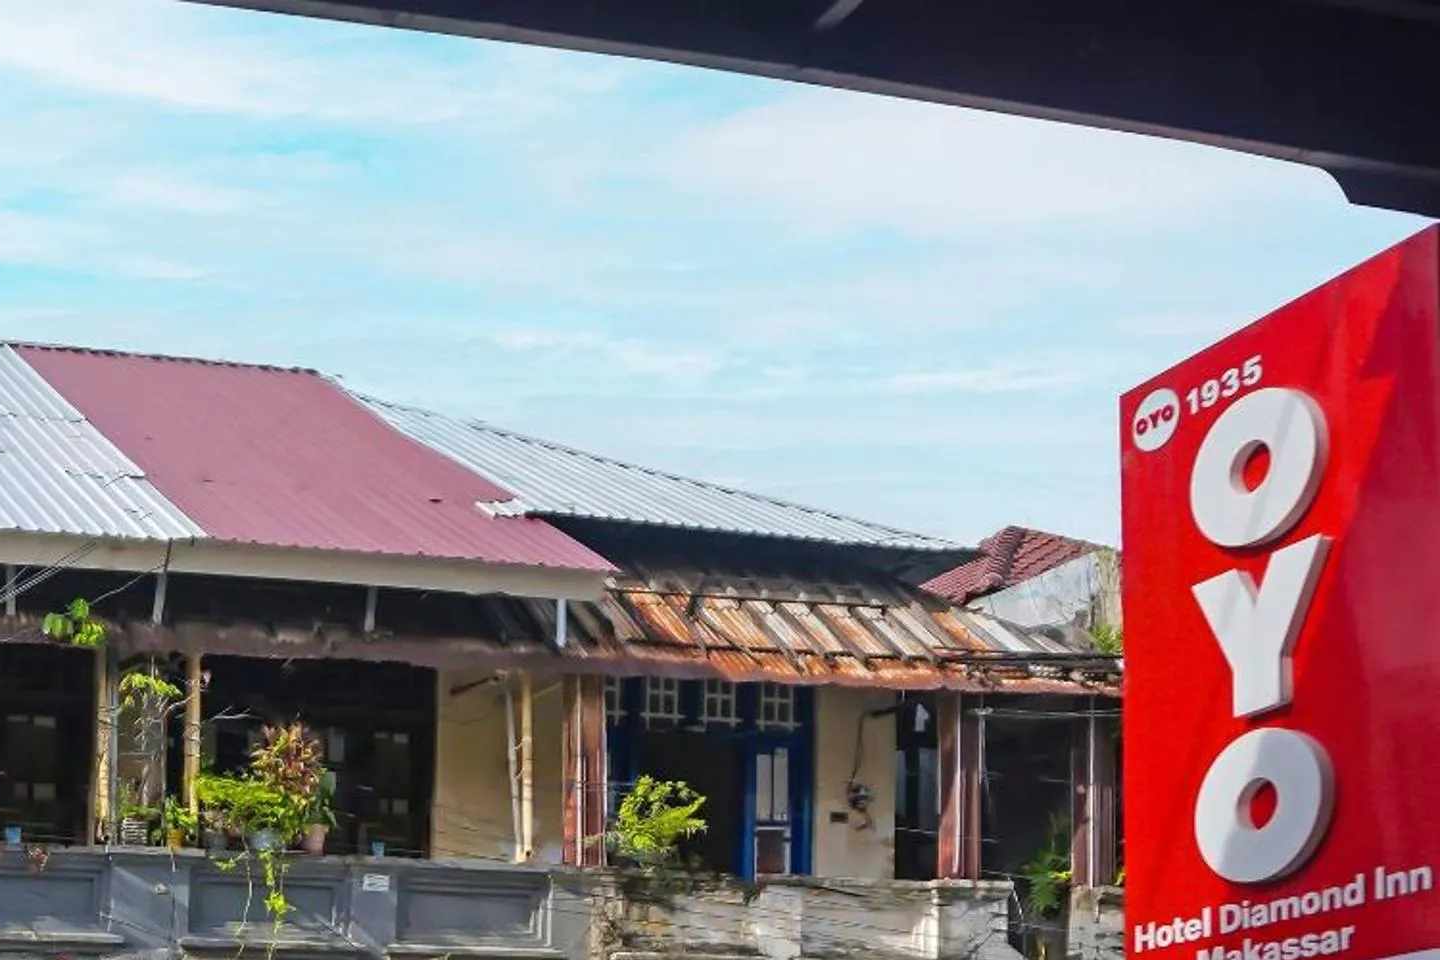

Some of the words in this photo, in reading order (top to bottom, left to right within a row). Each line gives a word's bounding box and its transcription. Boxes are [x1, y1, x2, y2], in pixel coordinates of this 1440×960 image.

[1136, 404, 1175, 436] OYO
[1186, 355, 1263, 415] 1935
[1190, 387, 1333, 884] OYO
[1134, 906, 1212, 952] Hotel
[1219, 873, 1366, 935] Diamond
[1375, 866, 1433, 900] Inn
